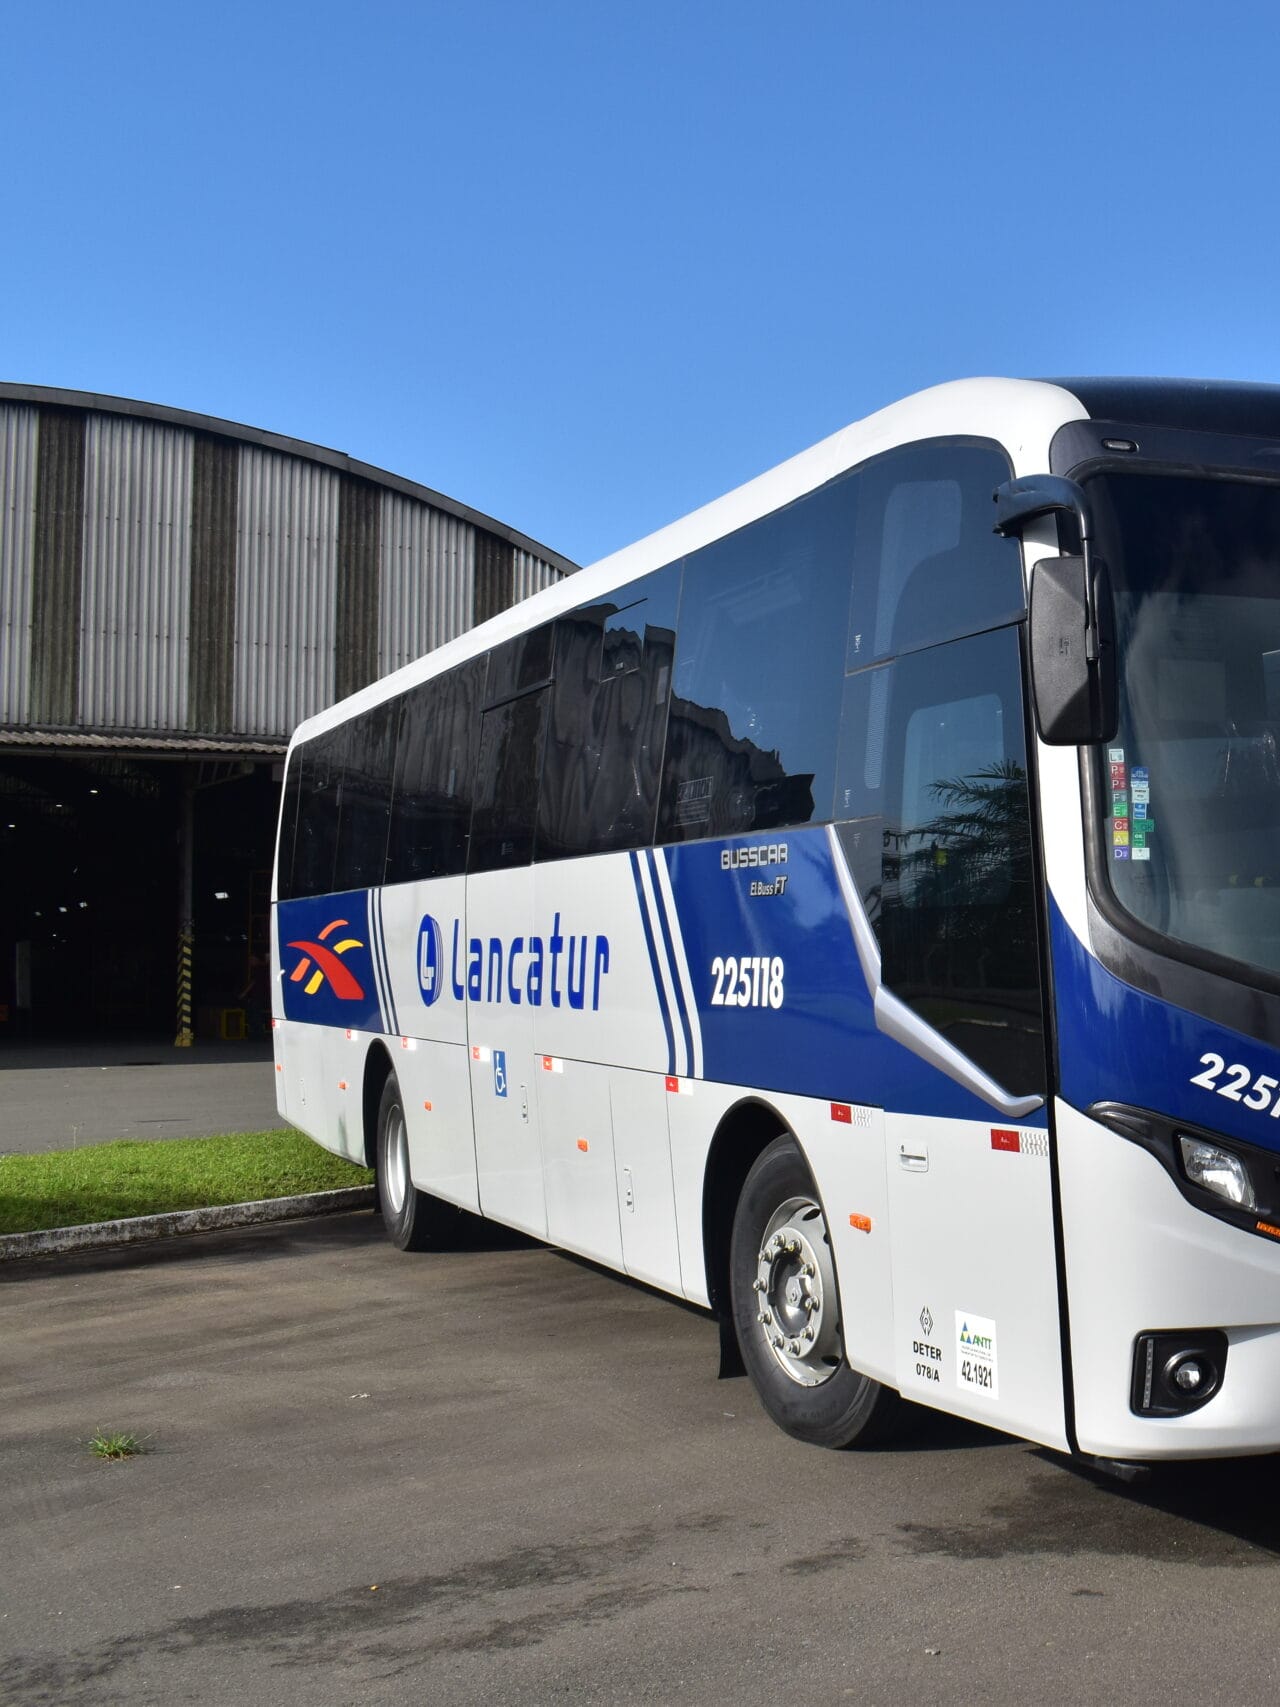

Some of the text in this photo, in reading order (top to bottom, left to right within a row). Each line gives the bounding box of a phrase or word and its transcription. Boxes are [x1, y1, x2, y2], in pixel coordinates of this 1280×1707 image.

[721, 843, 788, 870] BUSSCAR
[774, 876, 788, 895] FT
[452, 912, 610, 1011] Lancatur
[711, 956, 784, 1009] 225118
[913, 1340, 942, 1362] DETER
[972, 1334, 992, 1350] ANTT
[916, 1362, 940, 1382] 078/A
[961, 1359, 993, 1389] 42.1921
